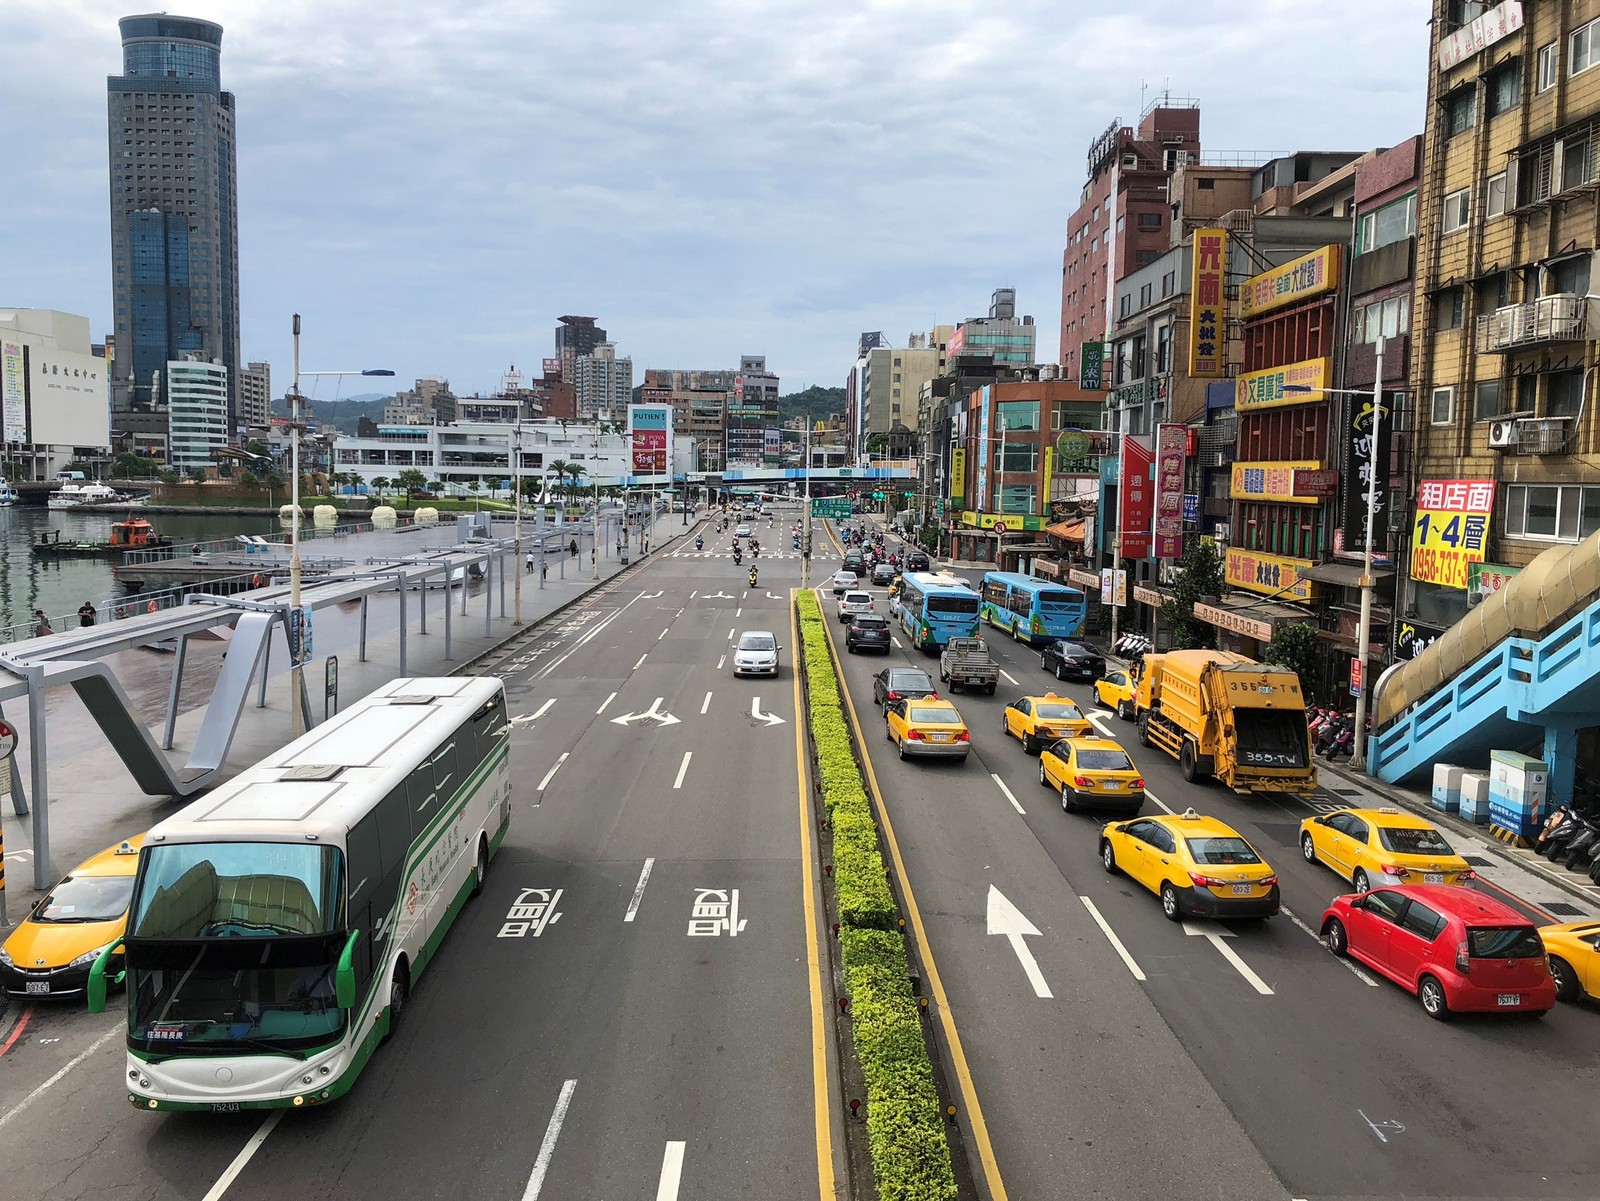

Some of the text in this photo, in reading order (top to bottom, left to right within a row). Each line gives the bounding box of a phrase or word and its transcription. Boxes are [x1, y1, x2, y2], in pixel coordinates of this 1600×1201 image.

[1421, 482, 1493, 512] 租店面
[1229, 553, 1280, 588] 光南大批發
[1246, 752, 1296, 764] 355-TW
[212, 1102, 240, 1112] 752-U3
